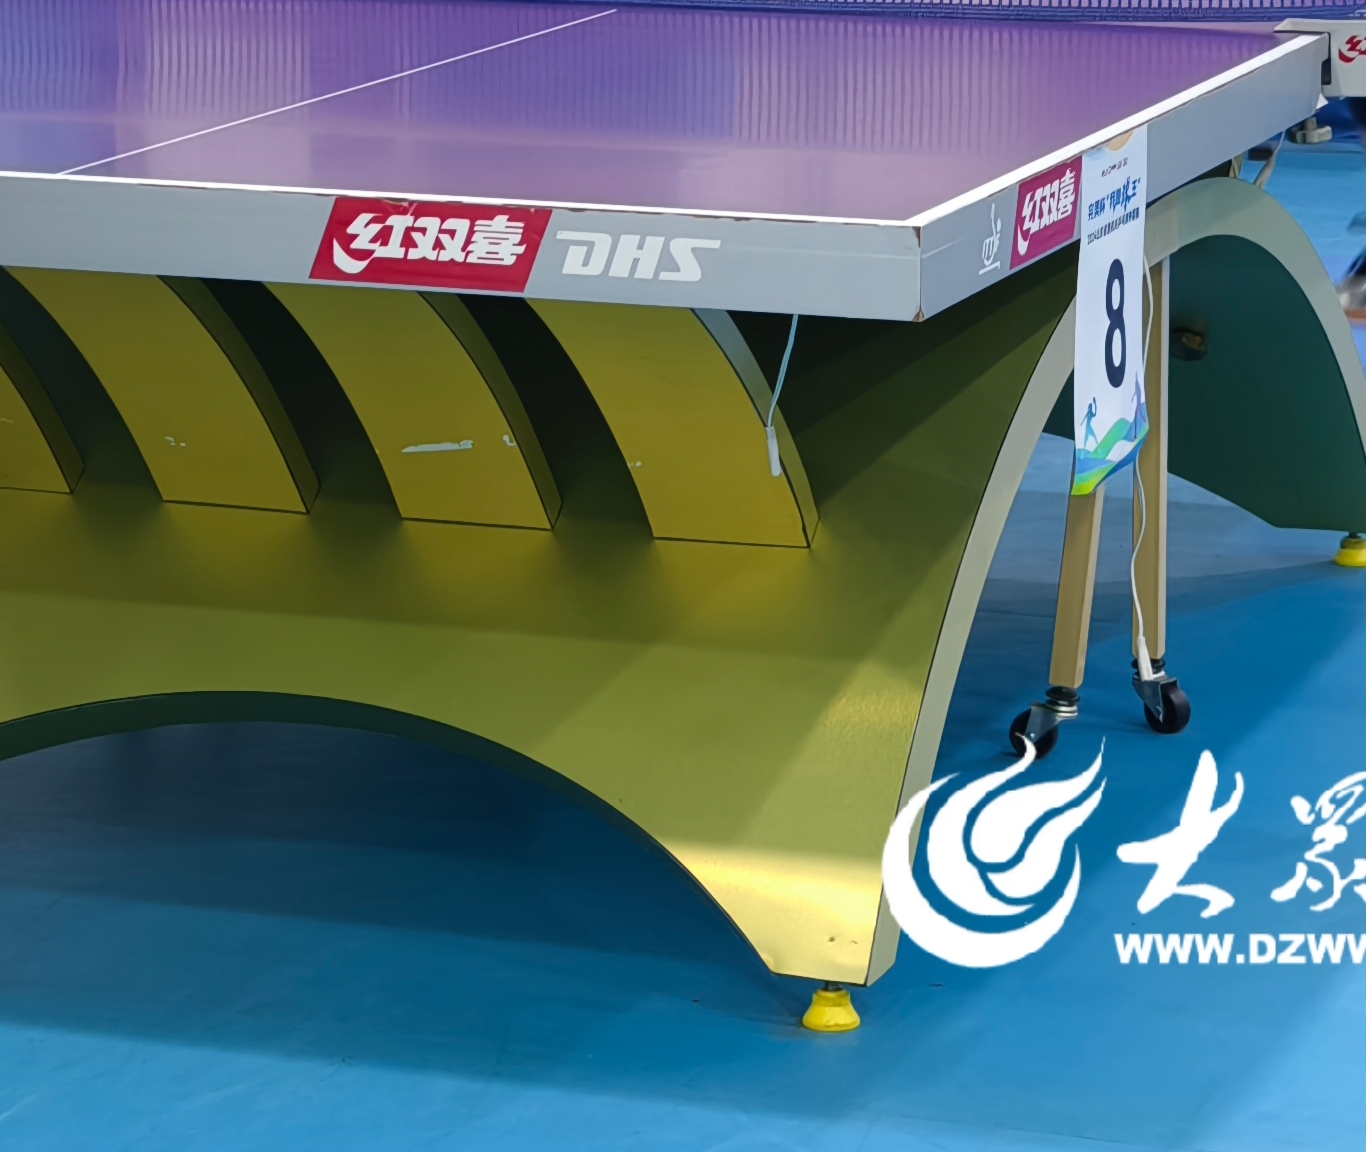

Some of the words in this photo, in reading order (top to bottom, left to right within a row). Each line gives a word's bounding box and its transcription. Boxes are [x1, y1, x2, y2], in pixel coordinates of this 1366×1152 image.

[332, 212, 527, 275] 红双喜
[555, 231, 721, 282] DHS
[1017, 167, 1076, 256] 红双喜
[1105, 258, 1127, 389] 8
